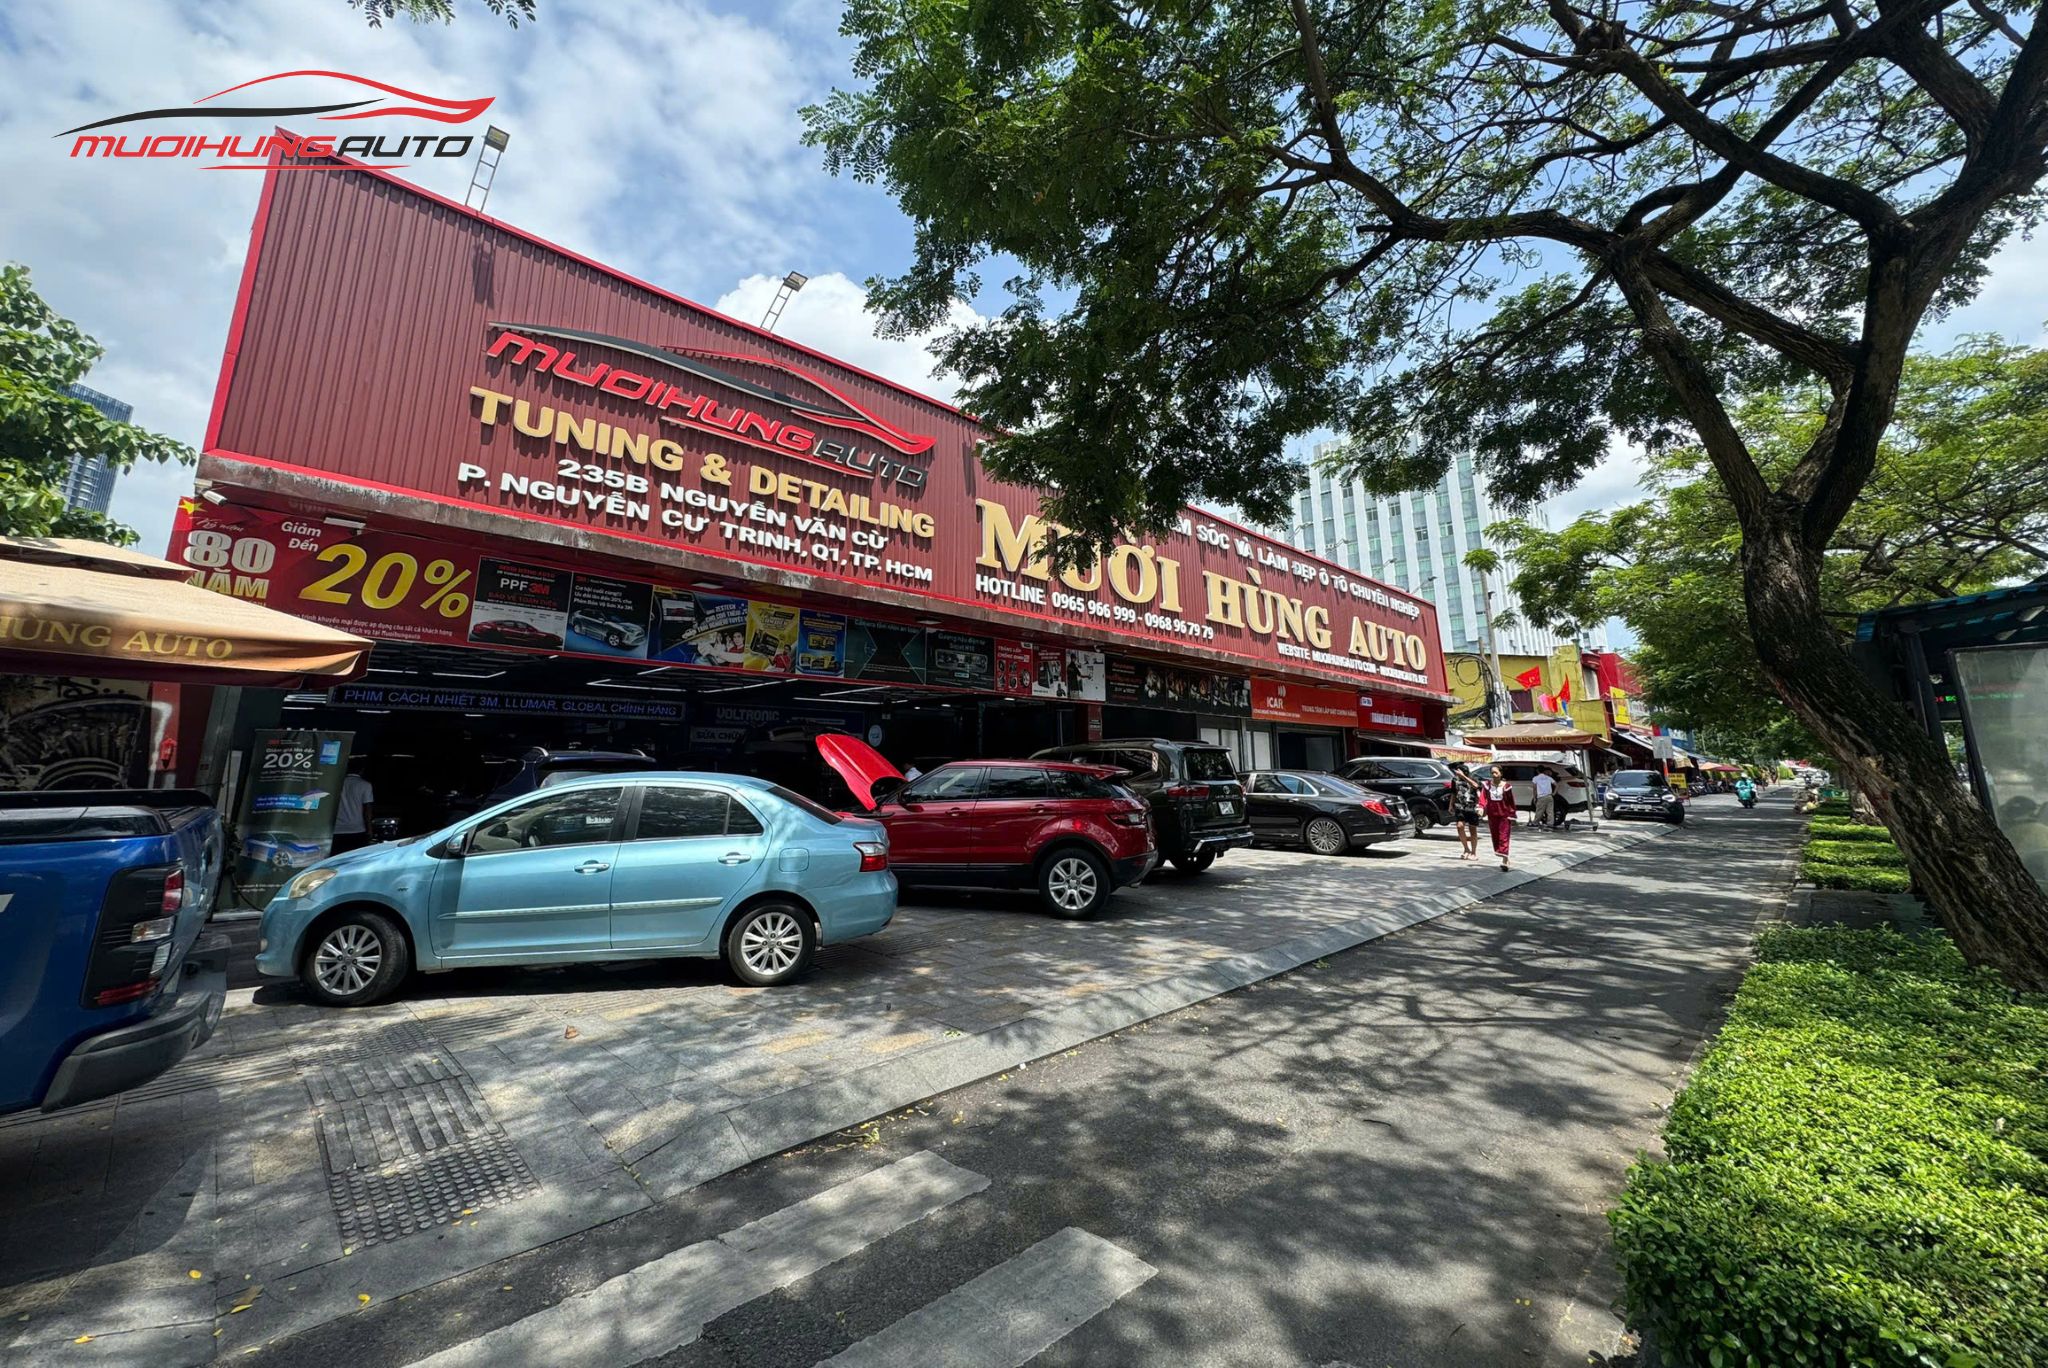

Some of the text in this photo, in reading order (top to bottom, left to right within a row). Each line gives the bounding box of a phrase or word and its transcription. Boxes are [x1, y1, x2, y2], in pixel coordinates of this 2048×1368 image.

[487, 331, 928, 487] MUOIHUNGAUTO
[470, 386, 935, 537] TUNING & DETAILING
[281, 520, 322, 538] Giảm
[458, 462, 491, 487] P.
[500, 473, 650, 521] NGUYỄN
[661, 509, 709, 532] CƯ
[720, 521, 807, 557] TRINH,
[885, 559, 933, 581] HCM
[557, 459, 888, 549] 235B NGUYỄN VĂN CỪ
[183, 530, 276, 574] 80
[288, 537, 319, 552] Đến
[1196, 523, 1230, 549] SÓC
[1233, 535, 1253, 559] VÀ
[1257, 546, 1288, 572] LÀM
[1292, 561, 1316, 582] ĐẸP
[1331, 574, 1348, 592] TÔ
[1349, 582, 1389, 607] CHUYÊN
[298, 543, 472, 618] 20%
[500, 578, 550, 595] PPF 3M
[975, 575, 1047, 605] HOTLINE
[1052, 591, 1085, 612] 0965
[1088, 600, 1110, 618] 966
[1113, 605, 1135, 623] 999
[1145, 612, 1171, 631] 0968
[1174, 618, 1187, 633] 96
[1188, 622, 1201, 637] 79
[1202, 625, 1214, 640] 79
[122, 630, 233, 659] AUTO
[1202, 567, 1332, 649] HÙNG
[1348, 616, 1427, 671] AUTO
[344, 689, 383, 702] PHIM
[562, 701, 606, 713] GLOBAL
[716, 707, 779, 721] VOLTRONIC
[263, 753, 314, 768] 20%
